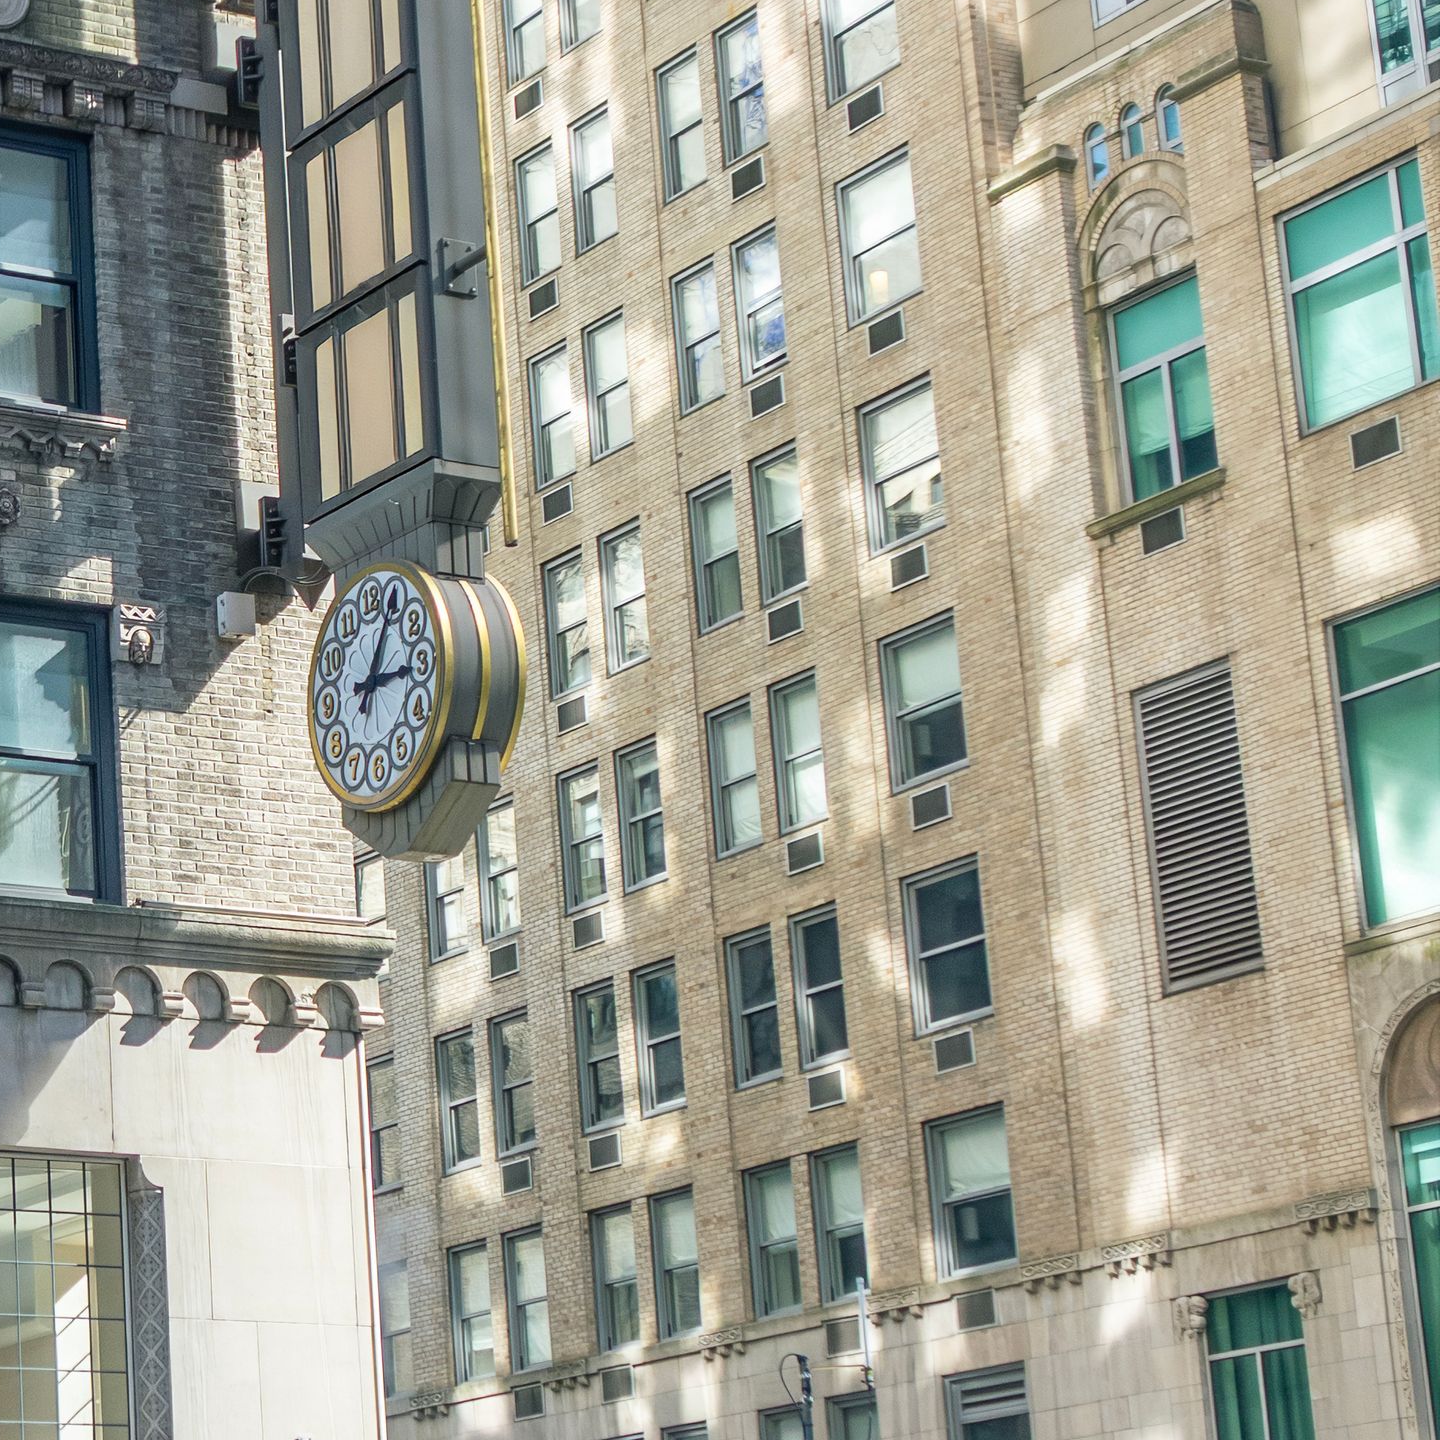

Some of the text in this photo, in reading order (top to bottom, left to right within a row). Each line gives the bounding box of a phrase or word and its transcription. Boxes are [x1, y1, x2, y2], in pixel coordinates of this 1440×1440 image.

[362, 585, 380, 615] 12
[341, 609, 356, 639] 11
[409, 610, 420, 637] 2
[324, 647, 342, 676] 10
[416, 650, 428, 675] 3
[322, 692, 334, 719] 9
[413, 693, 424, 722] 4
[330, 731, 342, 758] 8
[396, 733, 407, 760] 5
[349, 753, 360, 781] 7
[373, 756, 384, 782] 6
